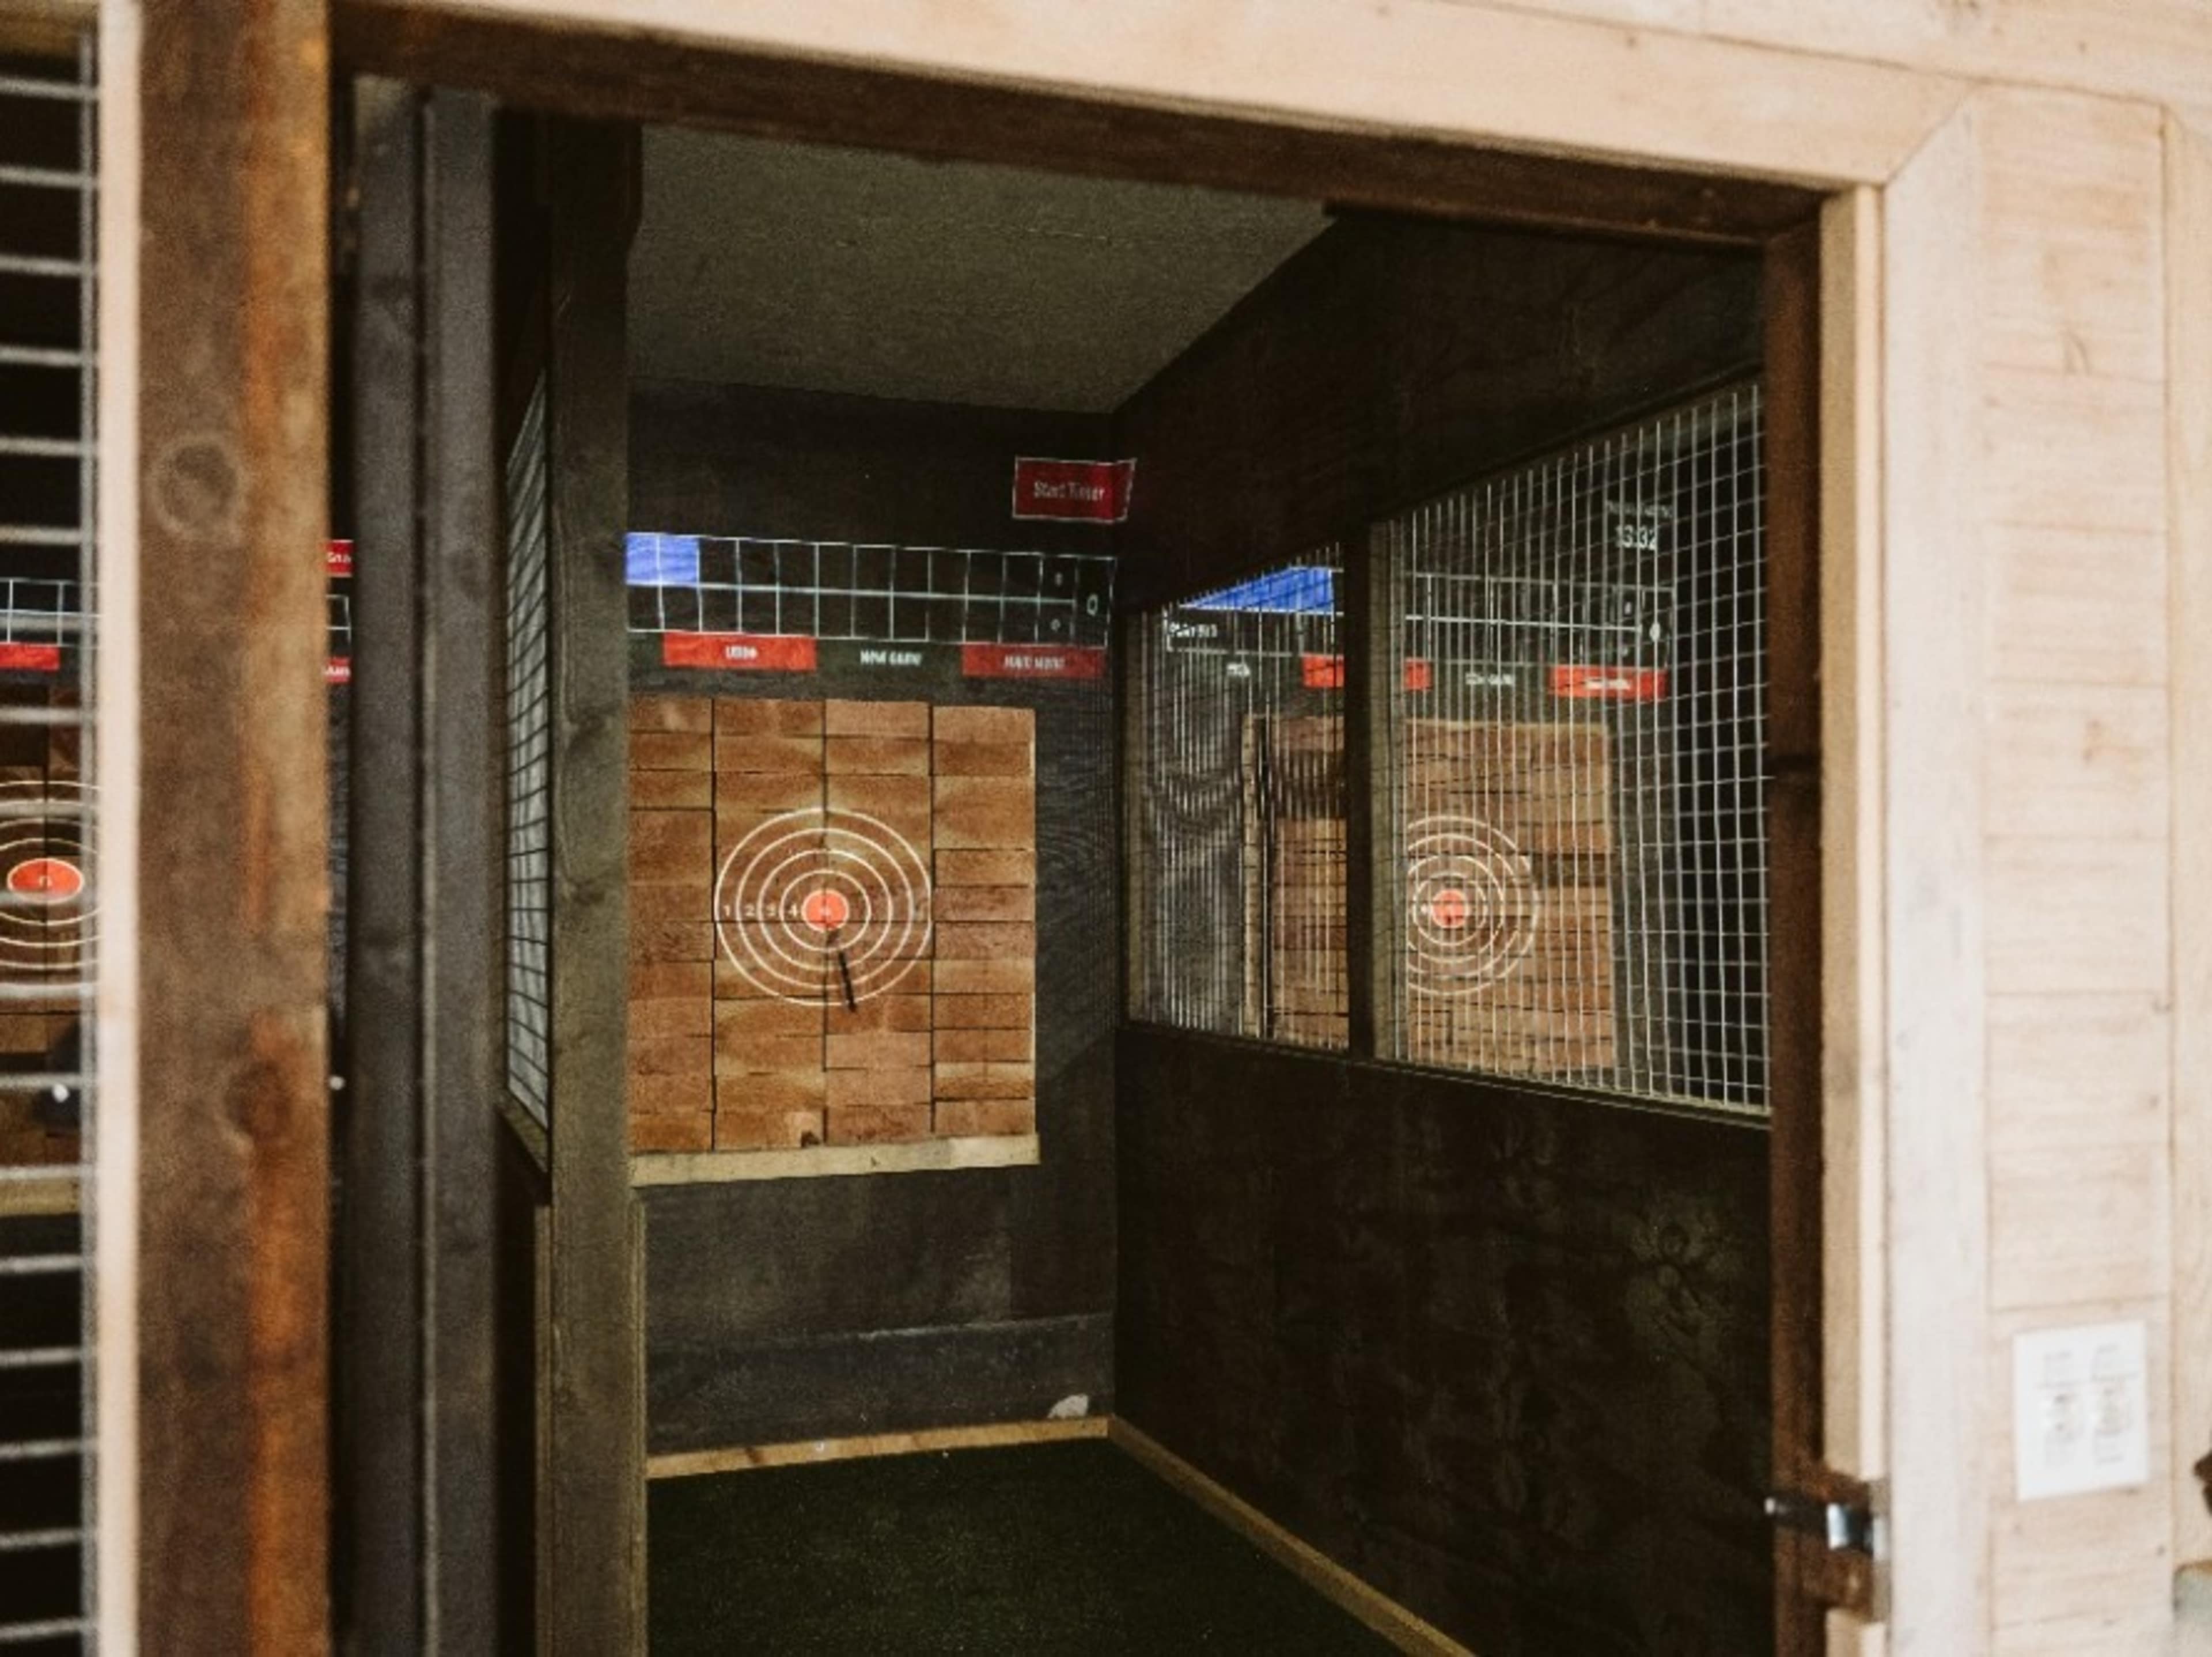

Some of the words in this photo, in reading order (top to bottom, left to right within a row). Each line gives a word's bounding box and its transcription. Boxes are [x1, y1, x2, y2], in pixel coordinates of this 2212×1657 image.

[1034, 480, 1065, 499] Start
[723, 904, 730, 916] 1
[745, 904, 756, 917] 2
[787, 903, 798, 917] 4
